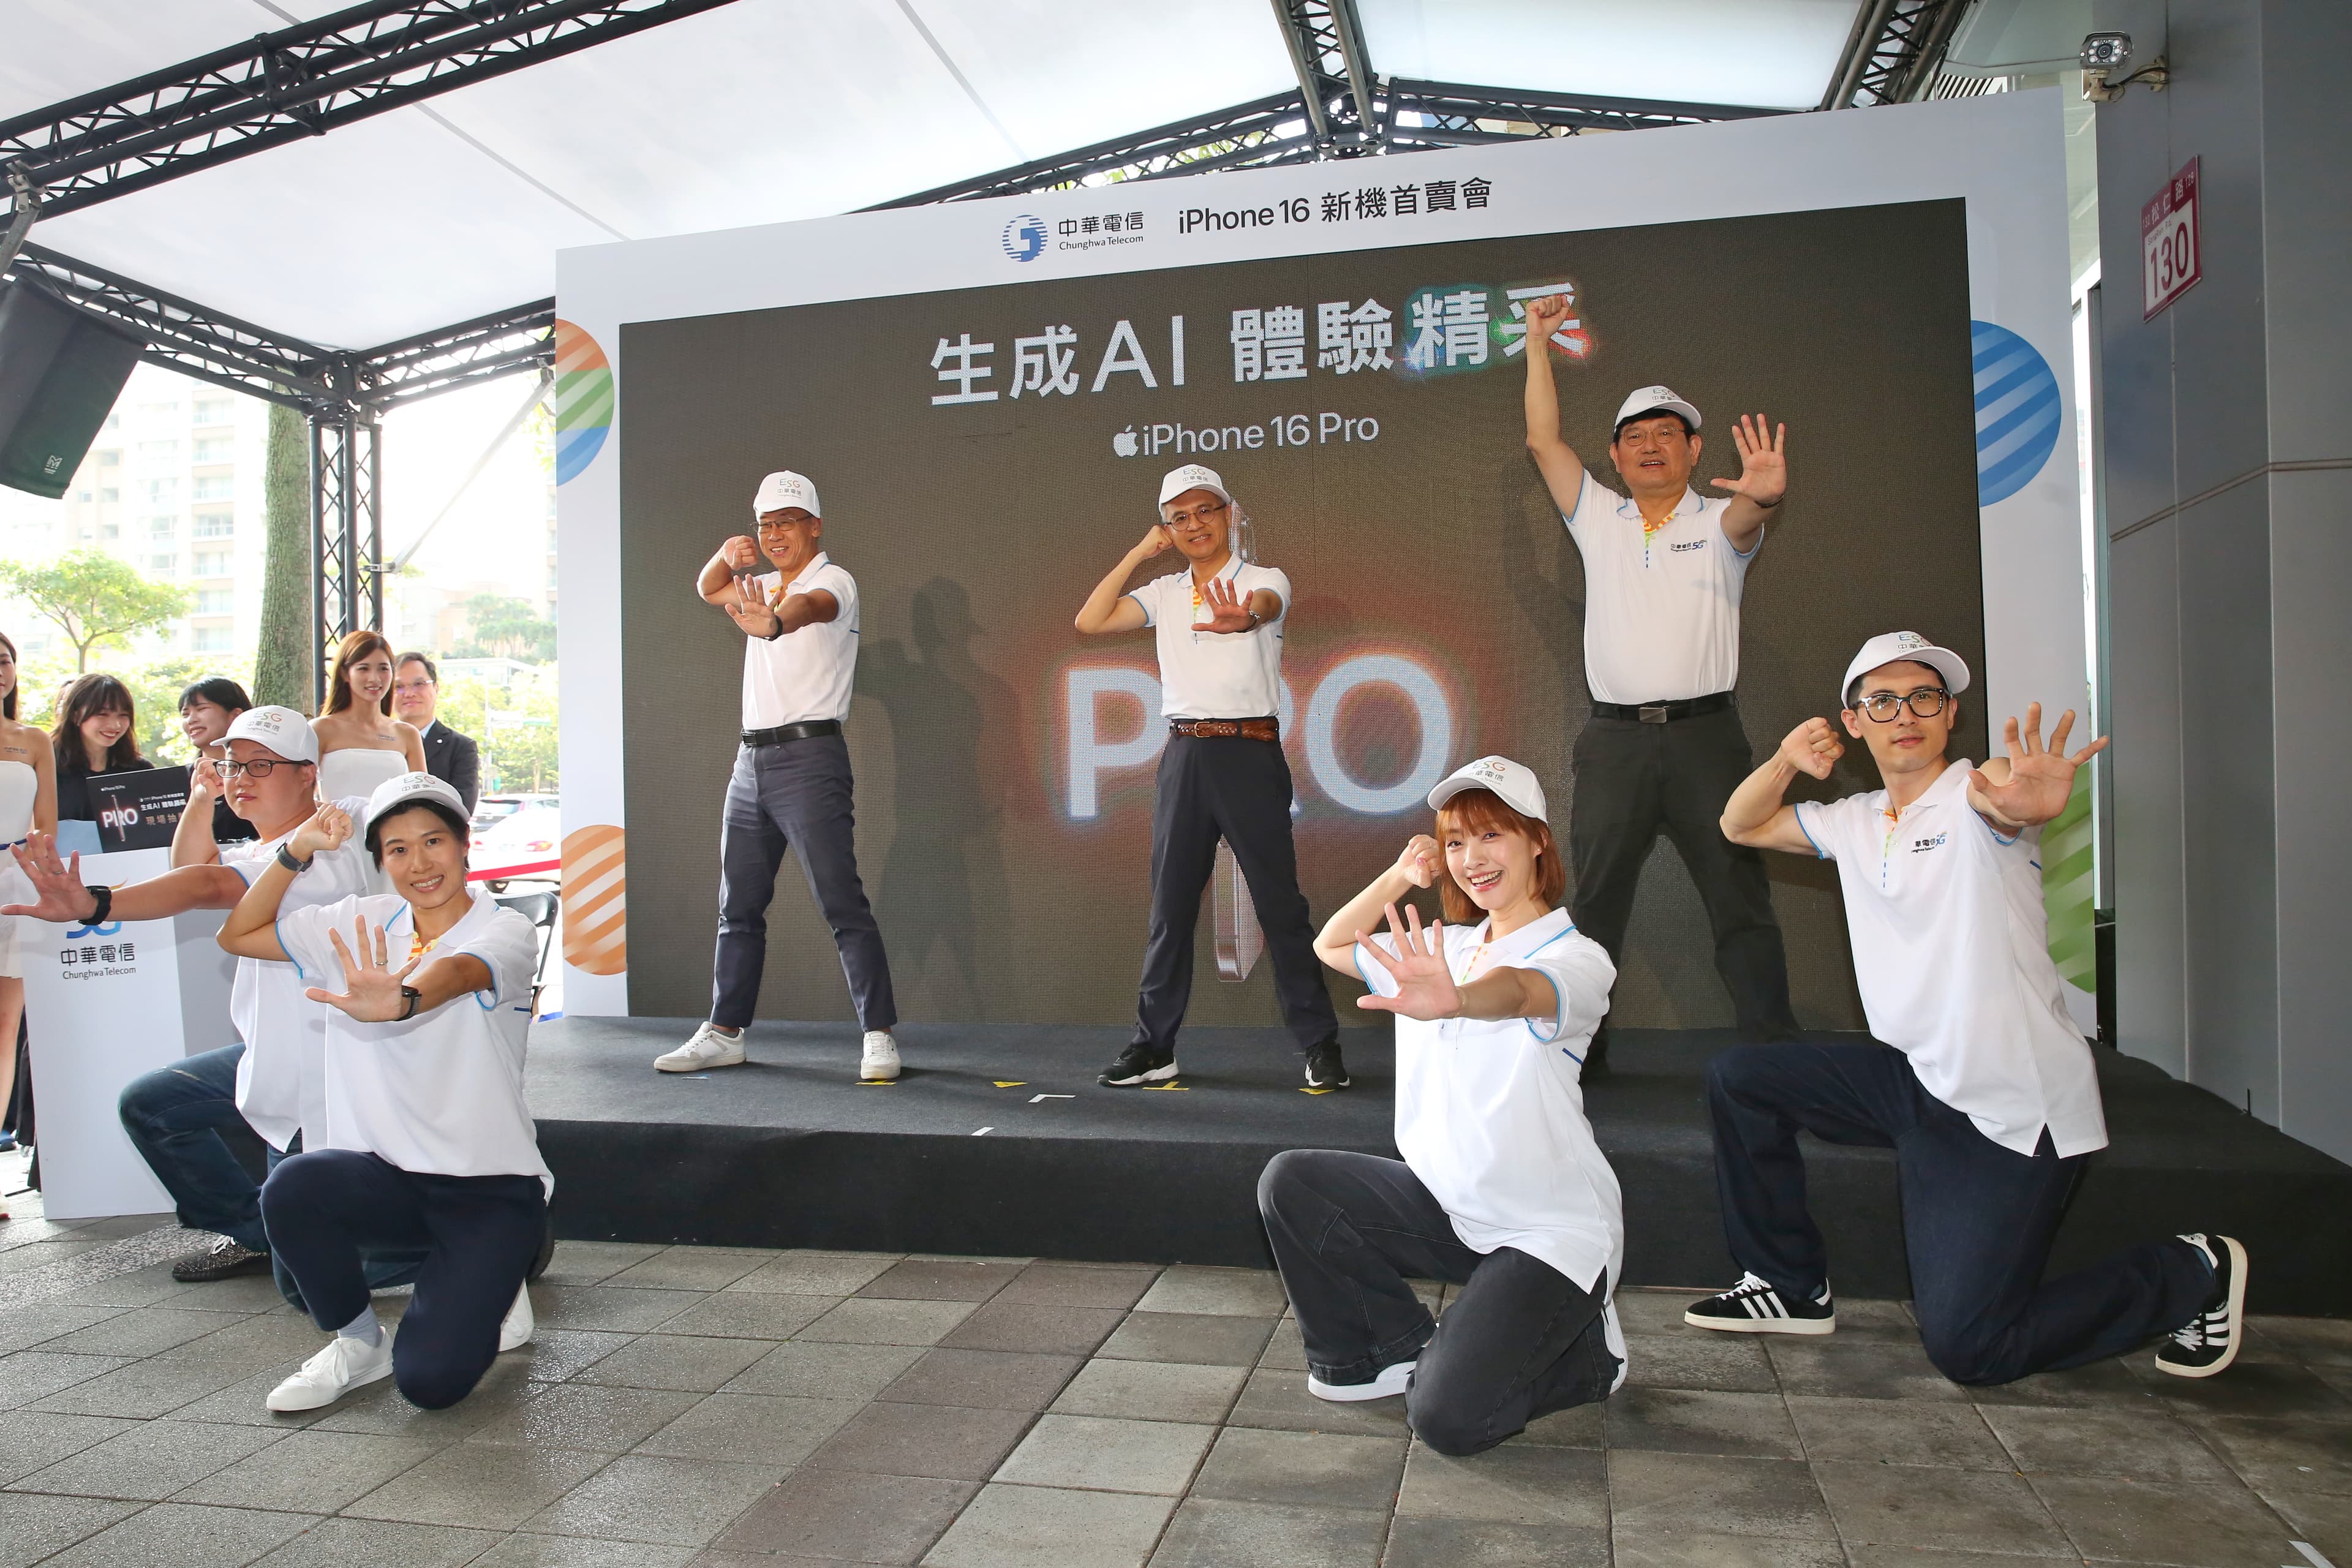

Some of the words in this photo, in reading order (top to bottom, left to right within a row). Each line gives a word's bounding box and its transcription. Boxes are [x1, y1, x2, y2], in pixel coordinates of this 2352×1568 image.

[1178, 207, 1275, 234] iPhone
[1278, 197, 1310, 224] 16
[1321, 176, 1493, 223] 新機首賣會
[2151, 178, 2184, 225] 松仁路
[1058, 211, 1144, 237] 中華電信
[1059, 239, 1106, 251] Chunghwa
[1107, 235, 1144, 246] Telecom
[2150, 222, 2189, 298] 130
[930, 315, 1185, 406] 生成AI
[1143, 422, 1265, 456] iPhone
[1270, 414, 1311, 447] 16
[1319, 412, 1379, 444] Pro
[779, 478, 801, 488] ESG
[1692, 540, 1705, 550] 5G
[254, 710, 282, 722] ESG
[246, 720, 281, 733] 中華電信
[1068, 653, 1452, 819] PO
[1472, 760, 1506, 772] ESG
[404, 775, 436, 785] ESG
[61, 943, 135, 967] 中華電信
[62, 969, 104, 981] Chunghwa
[104, 967, 137, 976] Telecom
